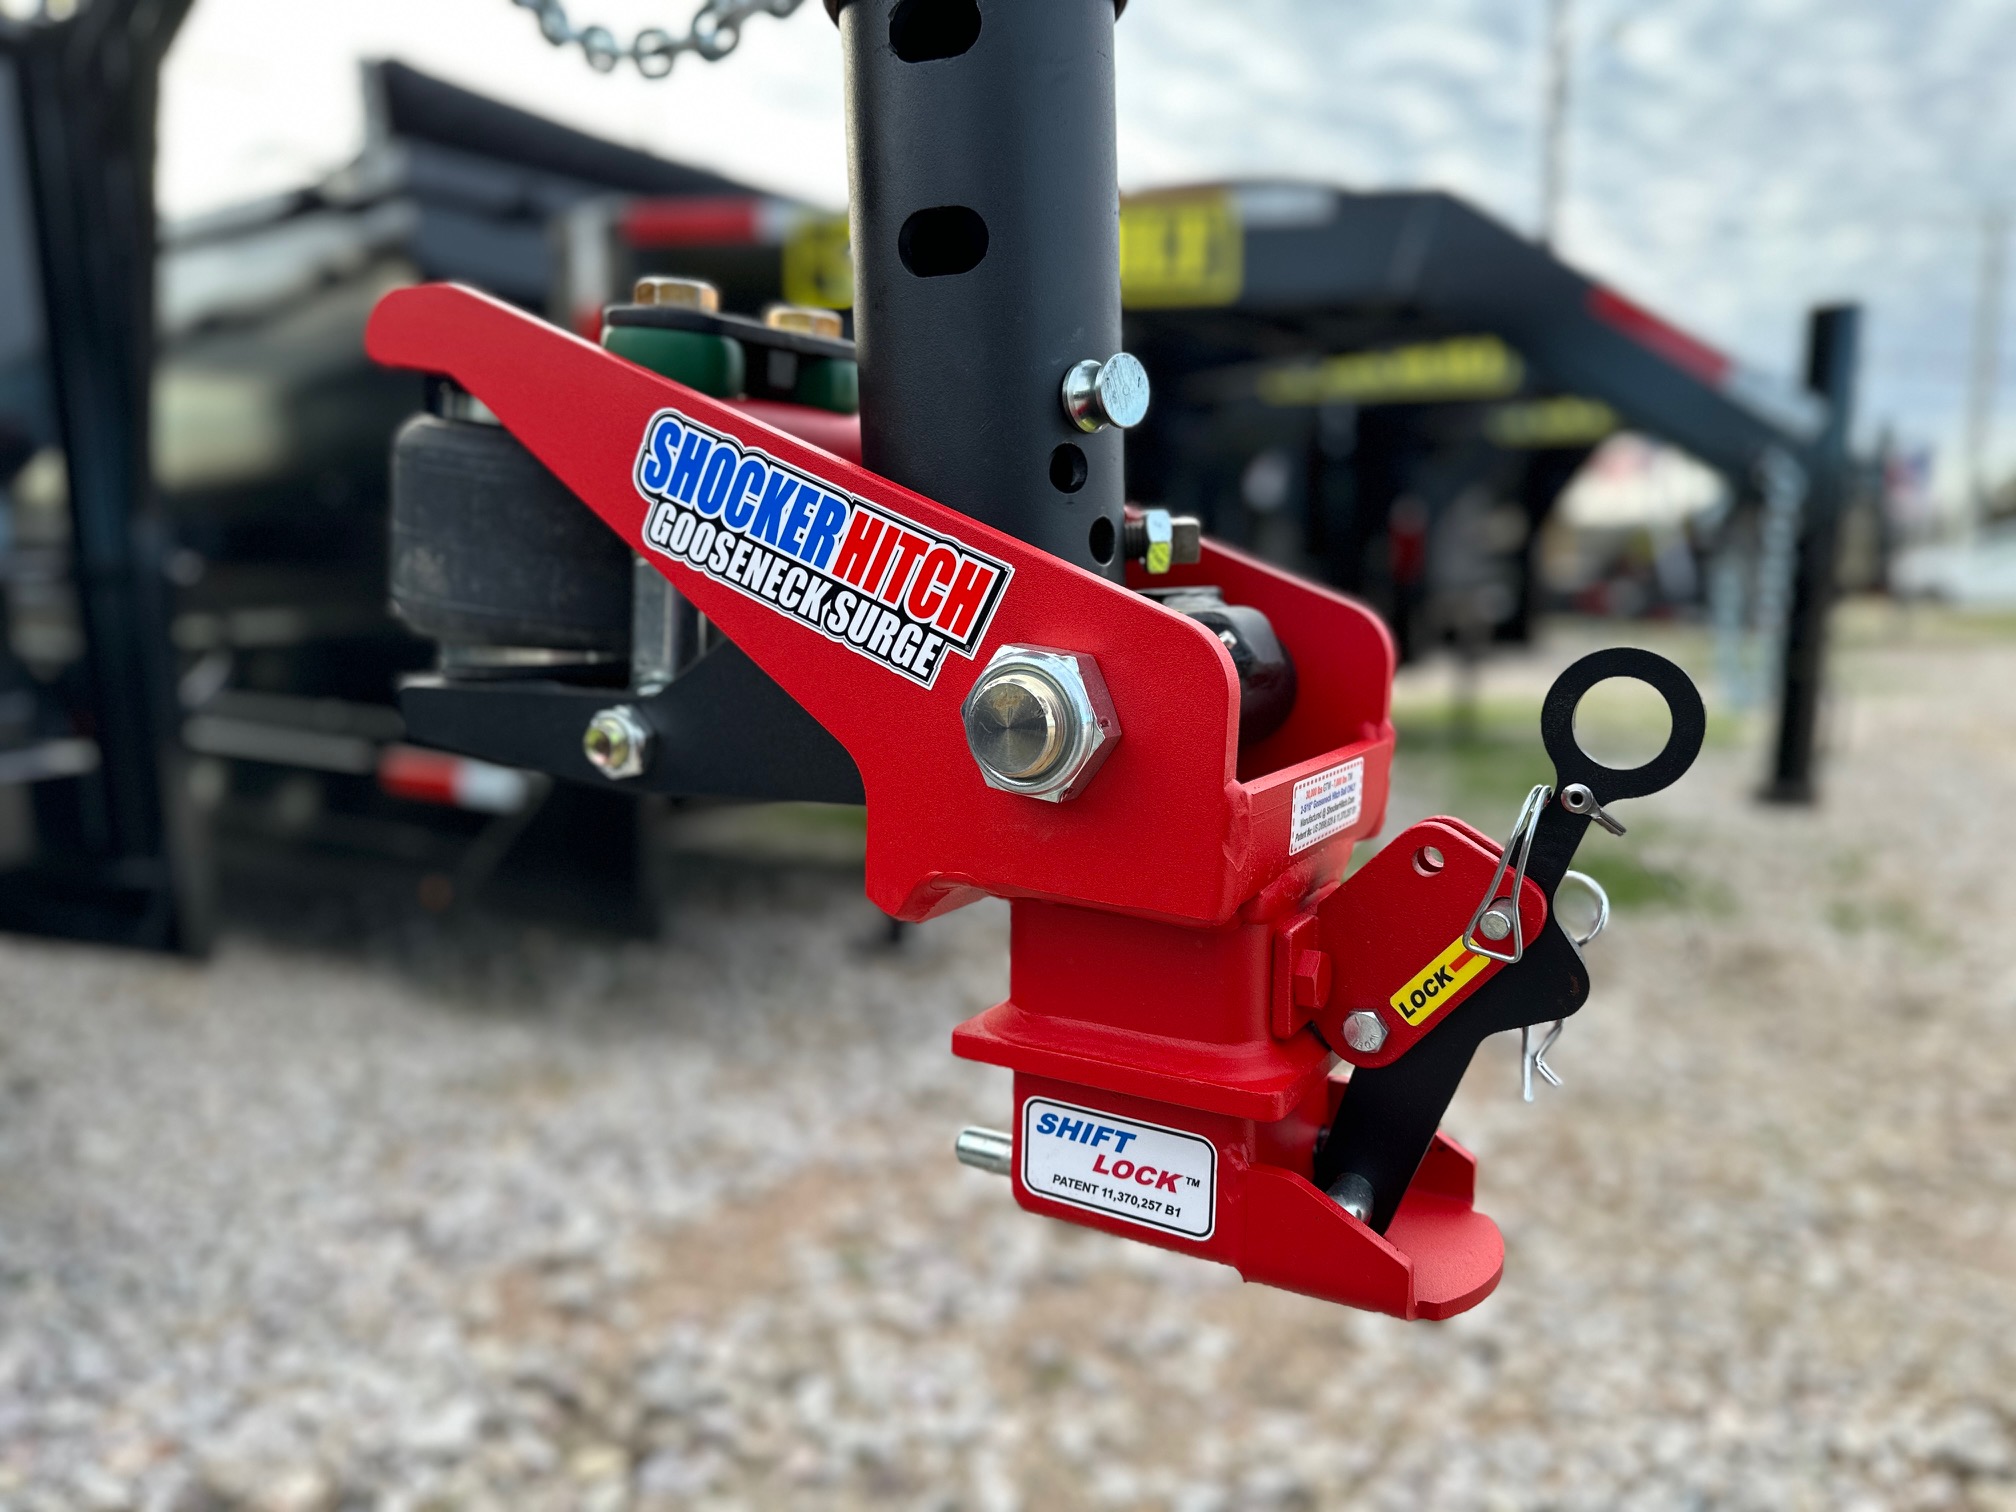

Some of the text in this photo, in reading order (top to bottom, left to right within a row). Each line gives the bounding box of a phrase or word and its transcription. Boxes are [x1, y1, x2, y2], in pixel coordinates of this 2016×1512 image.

[650, 505, 942, 677] GOOSENECK SURGE
[1399, 965, 1454, 1018] LOCK
[1037, 1113, 1136, 1153] SHIFT
[1053, 1174, 1181, 1217] PATENT 11,370,257 B1
